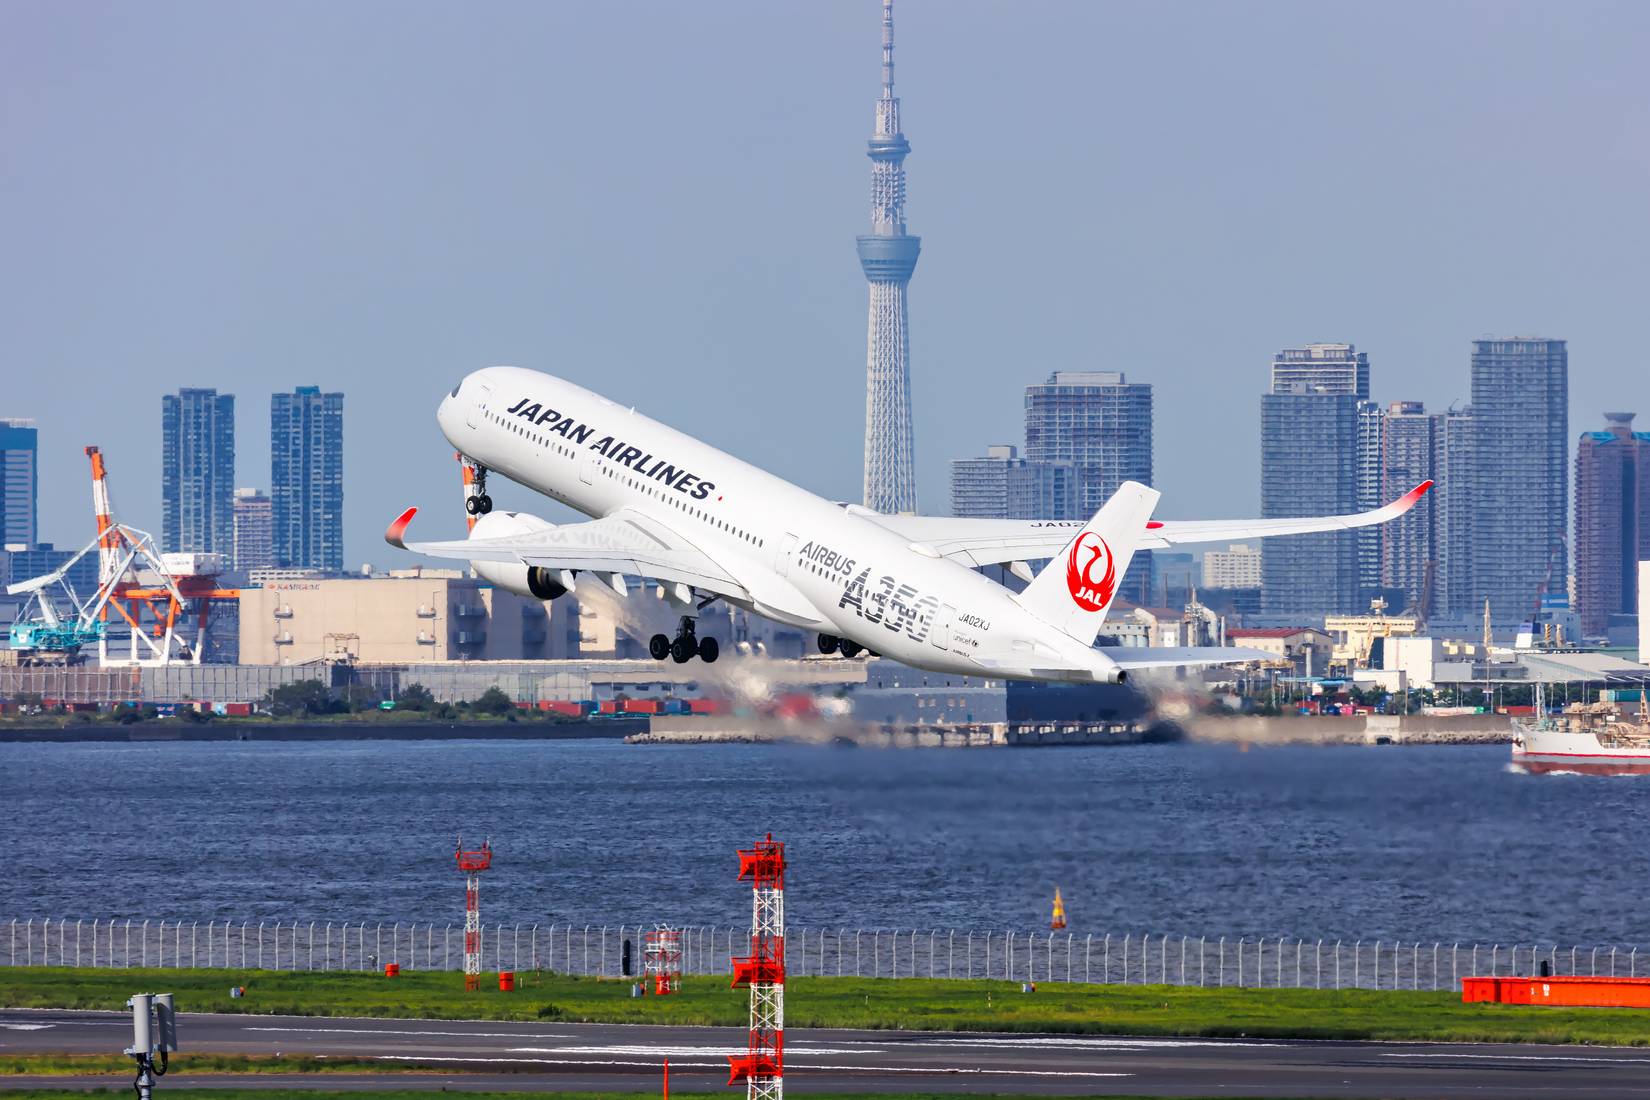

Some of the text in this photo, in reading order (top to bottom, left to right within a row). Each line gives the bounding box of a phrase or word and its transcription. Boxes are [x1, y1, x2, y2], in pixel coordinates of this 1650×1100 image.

[507, 398, 716, 500] JAPAN AIRLINES
[799, 541, 857, 576] AIRBUS
[839, 567, 939, 643] A350
[1075, 586, 1103, 607] JAL
[958, 613, 991, 631] JA02XJ
